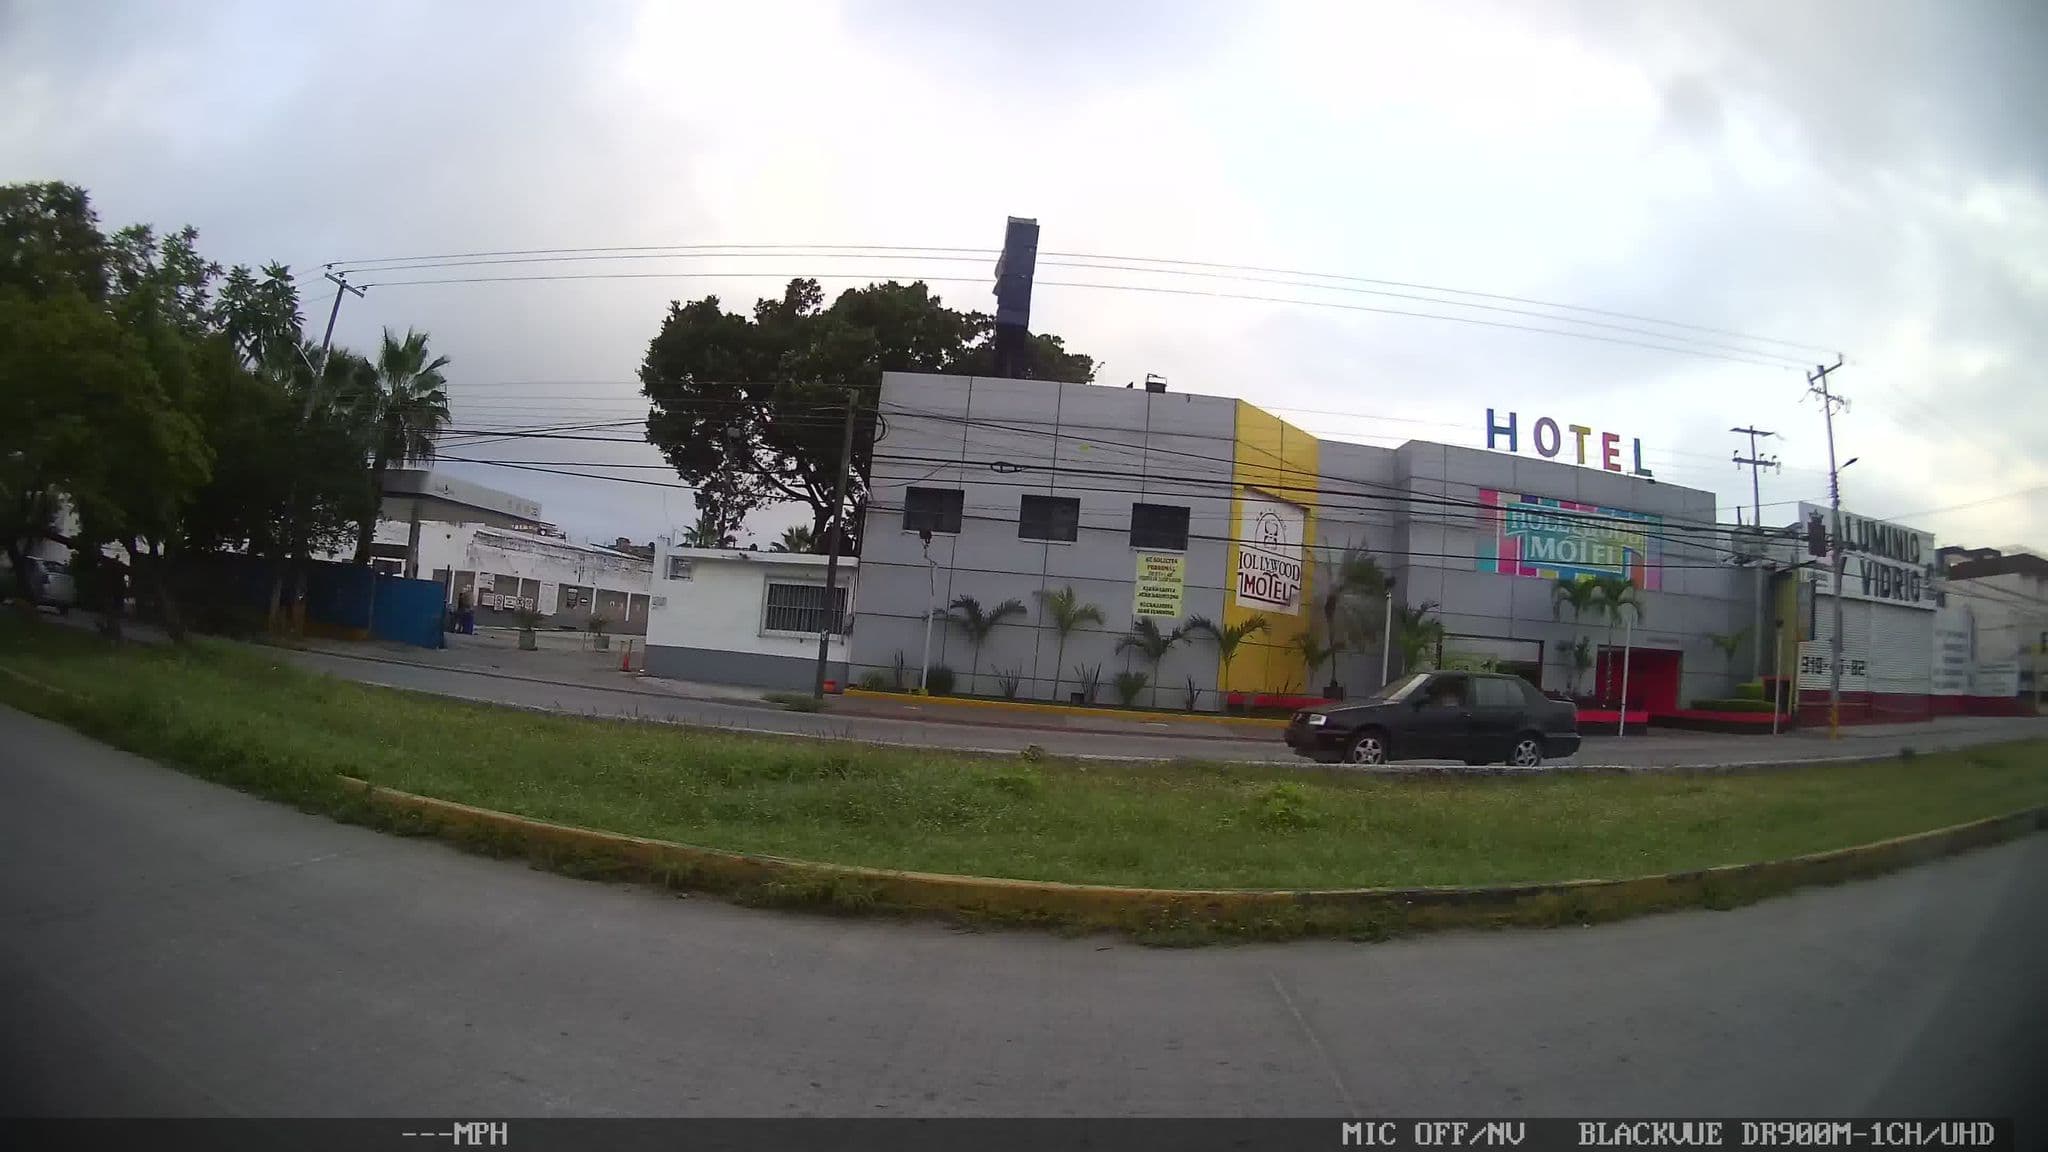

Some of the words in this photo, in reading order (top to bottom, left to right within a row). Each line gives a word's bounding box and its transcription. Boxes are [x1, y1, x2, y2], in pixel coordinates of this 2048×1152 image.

[1486, 408, 1653, 477] HOTEL
[1530, 535, 1614, 565] MOTEL
[1243, 572, 1289, 602] MOTEL
[1860, 559, 1920, 602] VIDRIO
